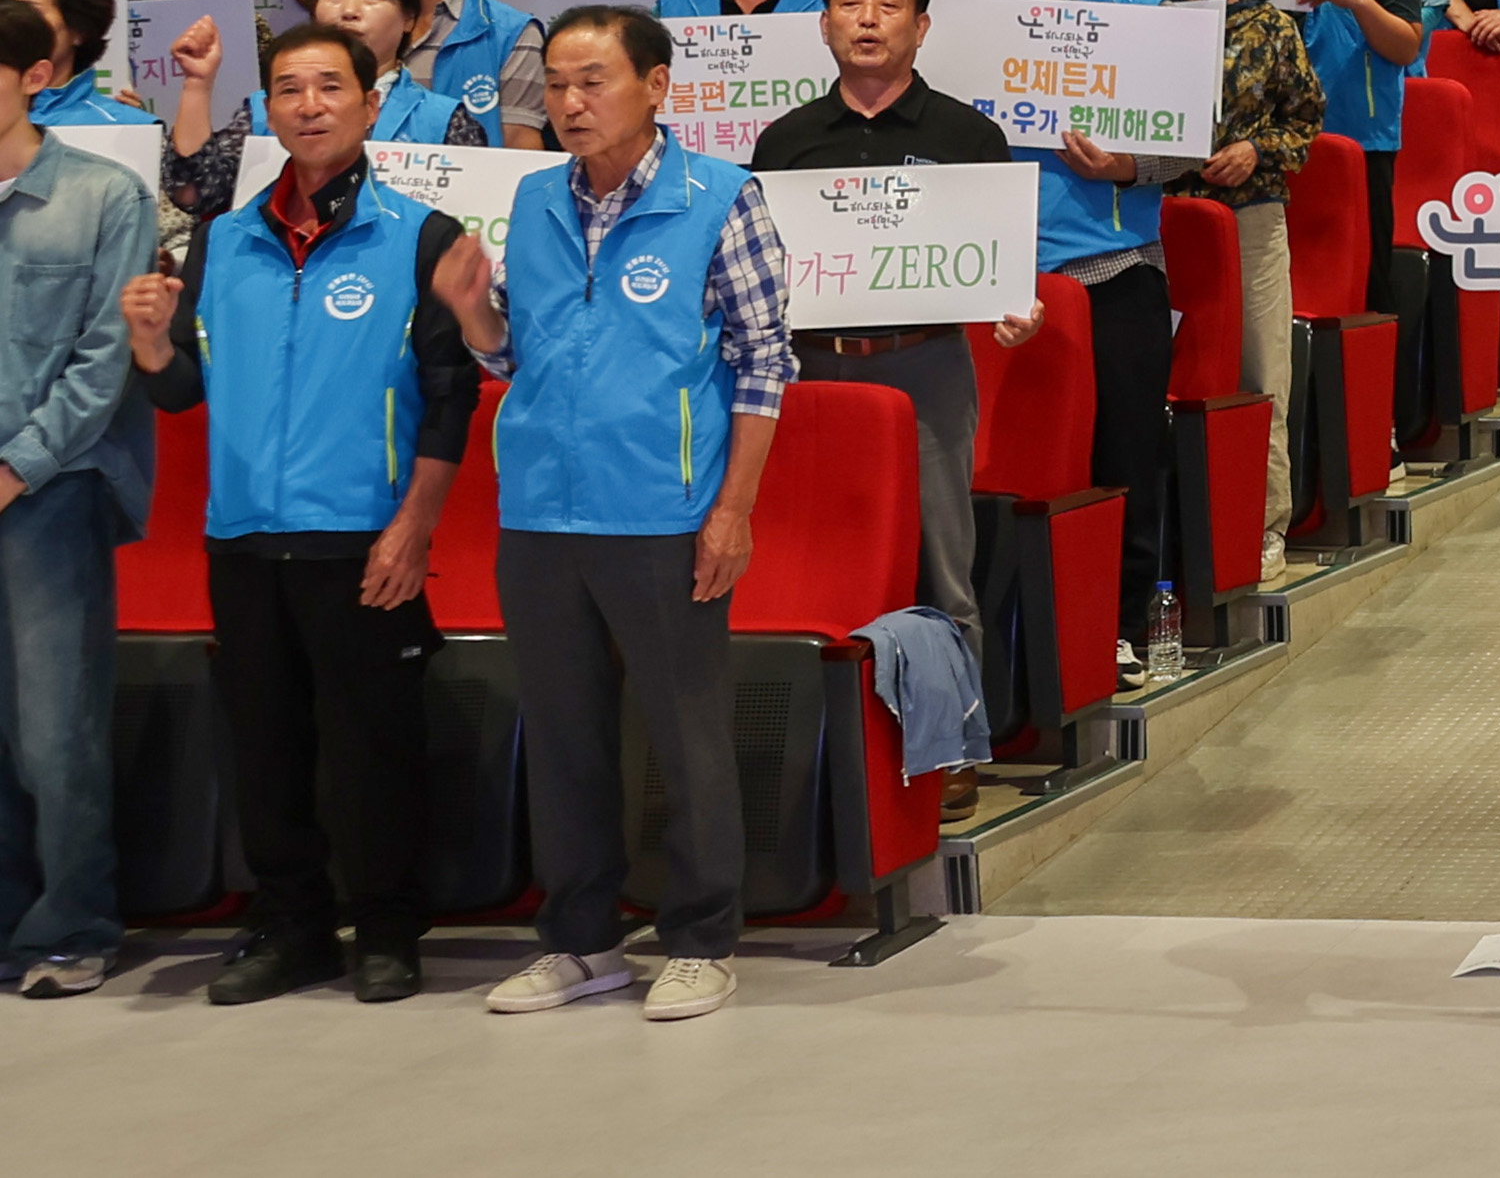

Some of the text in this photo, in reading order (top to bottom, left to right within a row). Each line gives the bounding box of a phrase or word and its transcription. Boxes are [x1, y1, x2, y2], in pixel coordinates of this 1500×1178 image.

[1003, 57, 1117, 99] 언제든지
[1069, 104, 1185, 142] 함께해요!
[869, 240, 998, 291] ZERO!
